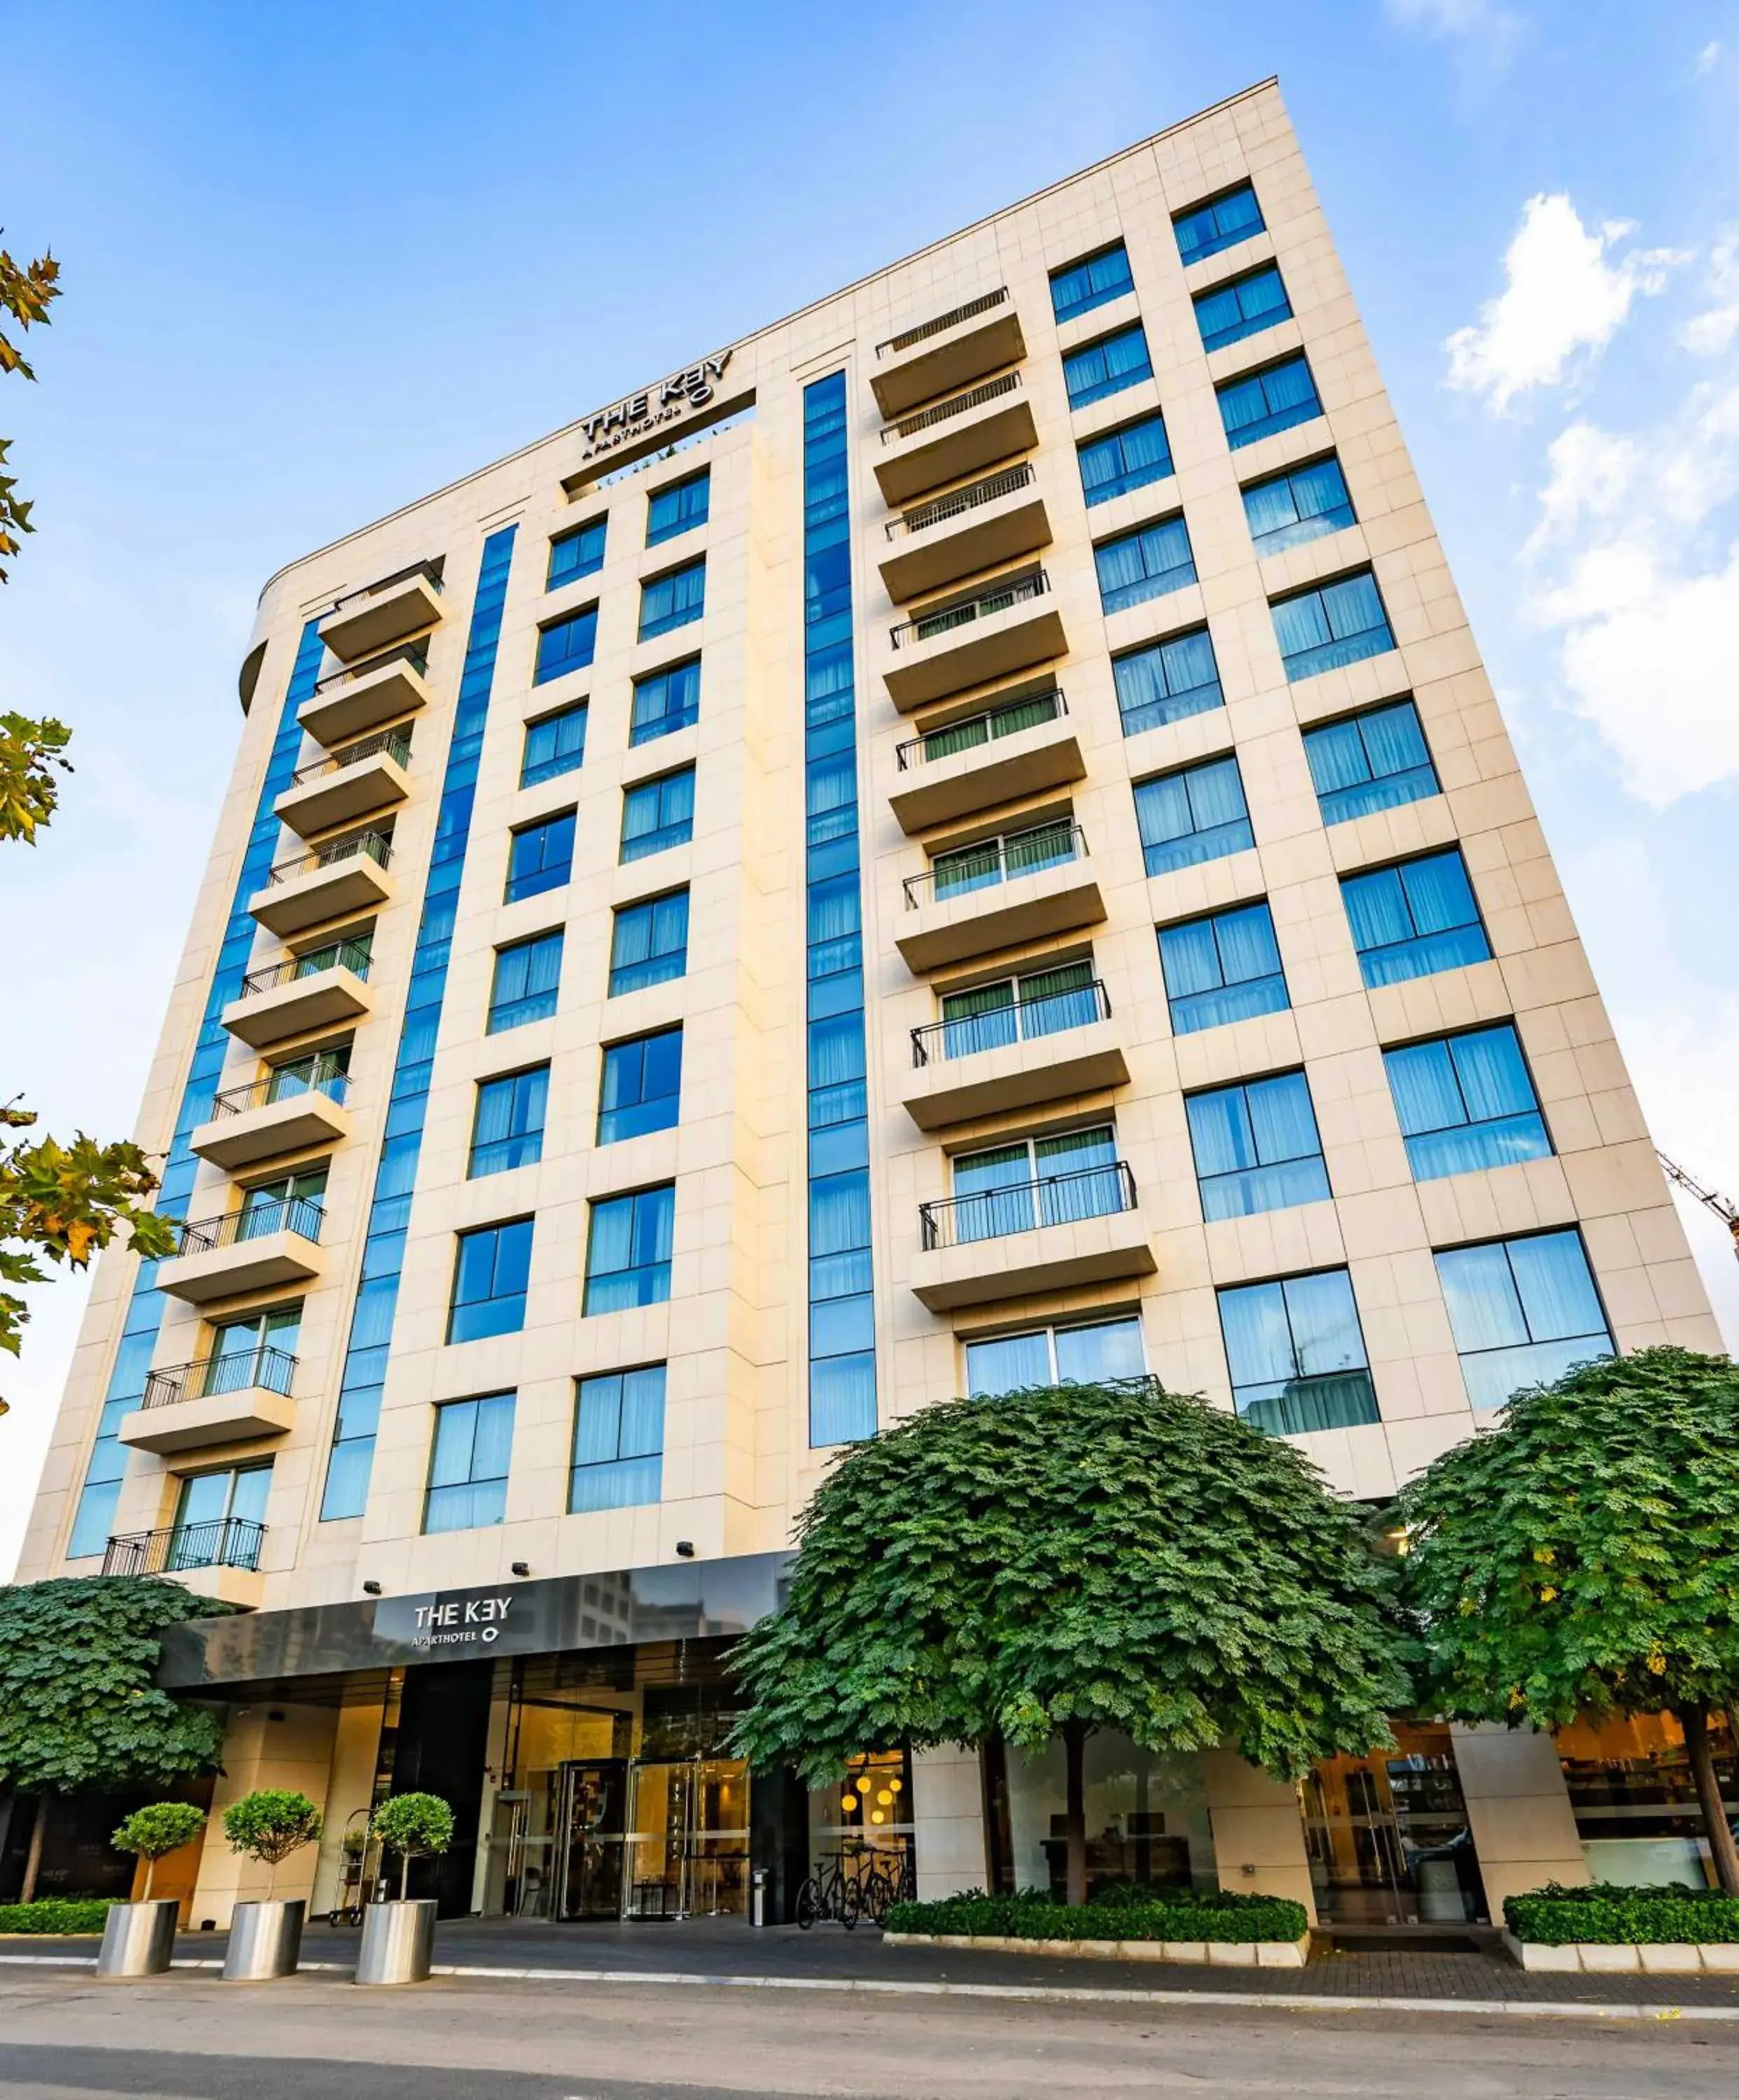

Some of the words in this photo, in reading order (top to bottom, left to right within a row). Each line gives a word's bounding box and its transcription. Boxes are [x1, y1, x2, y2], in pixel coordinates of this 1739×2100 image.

[582, 393, 648, 442] THE
[414, 1604, 459, 1628] THE
[412, 1632, 477, 1647] APARTHOTEL
